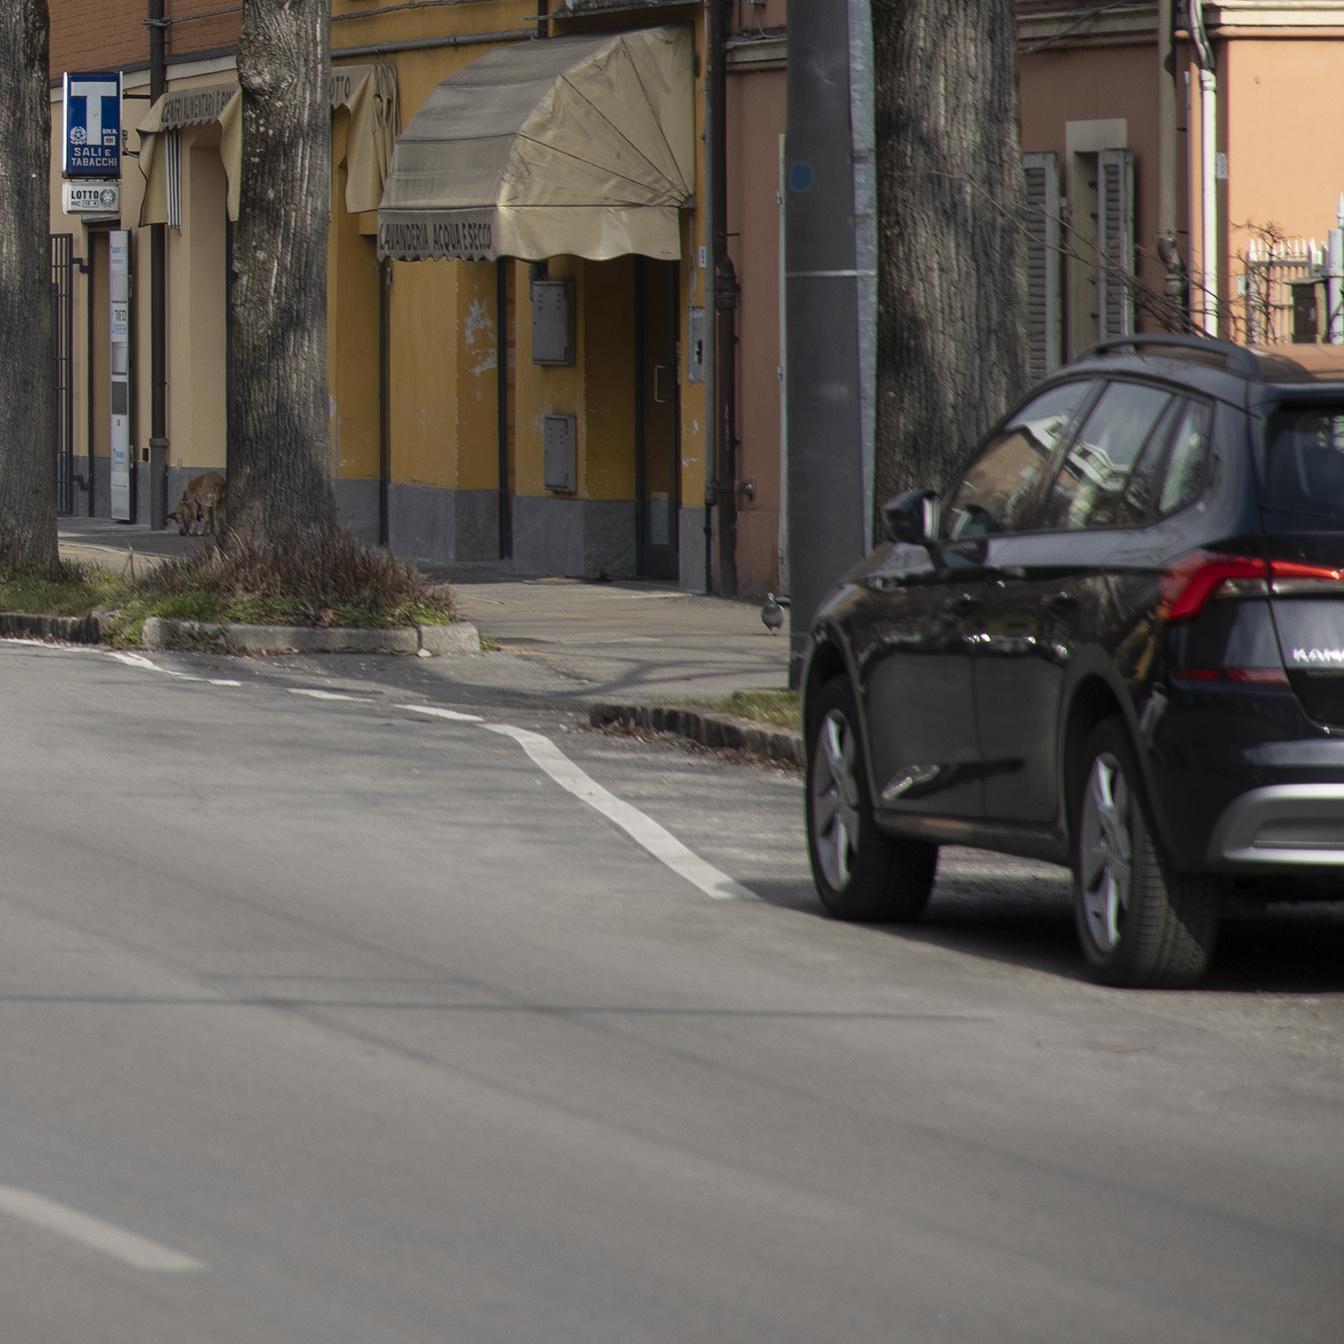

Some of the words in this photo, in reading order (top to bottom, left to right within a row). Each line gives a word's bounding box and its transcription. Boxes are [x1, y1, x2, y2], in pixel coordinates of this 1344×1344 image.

[329, 76, 351, 99] OTTO
[71, 81, 117, 145] T
[74, 147, 102, 156] SALI
[72, 157, 117, 167] TABACCHI
[71, 190, 99, 200] LOTTO
[379, 222, 429, 251] LAVANDERIA
[433, 222, 462, 252] ACQUA
[468, 222, 492, 250] SECCO
